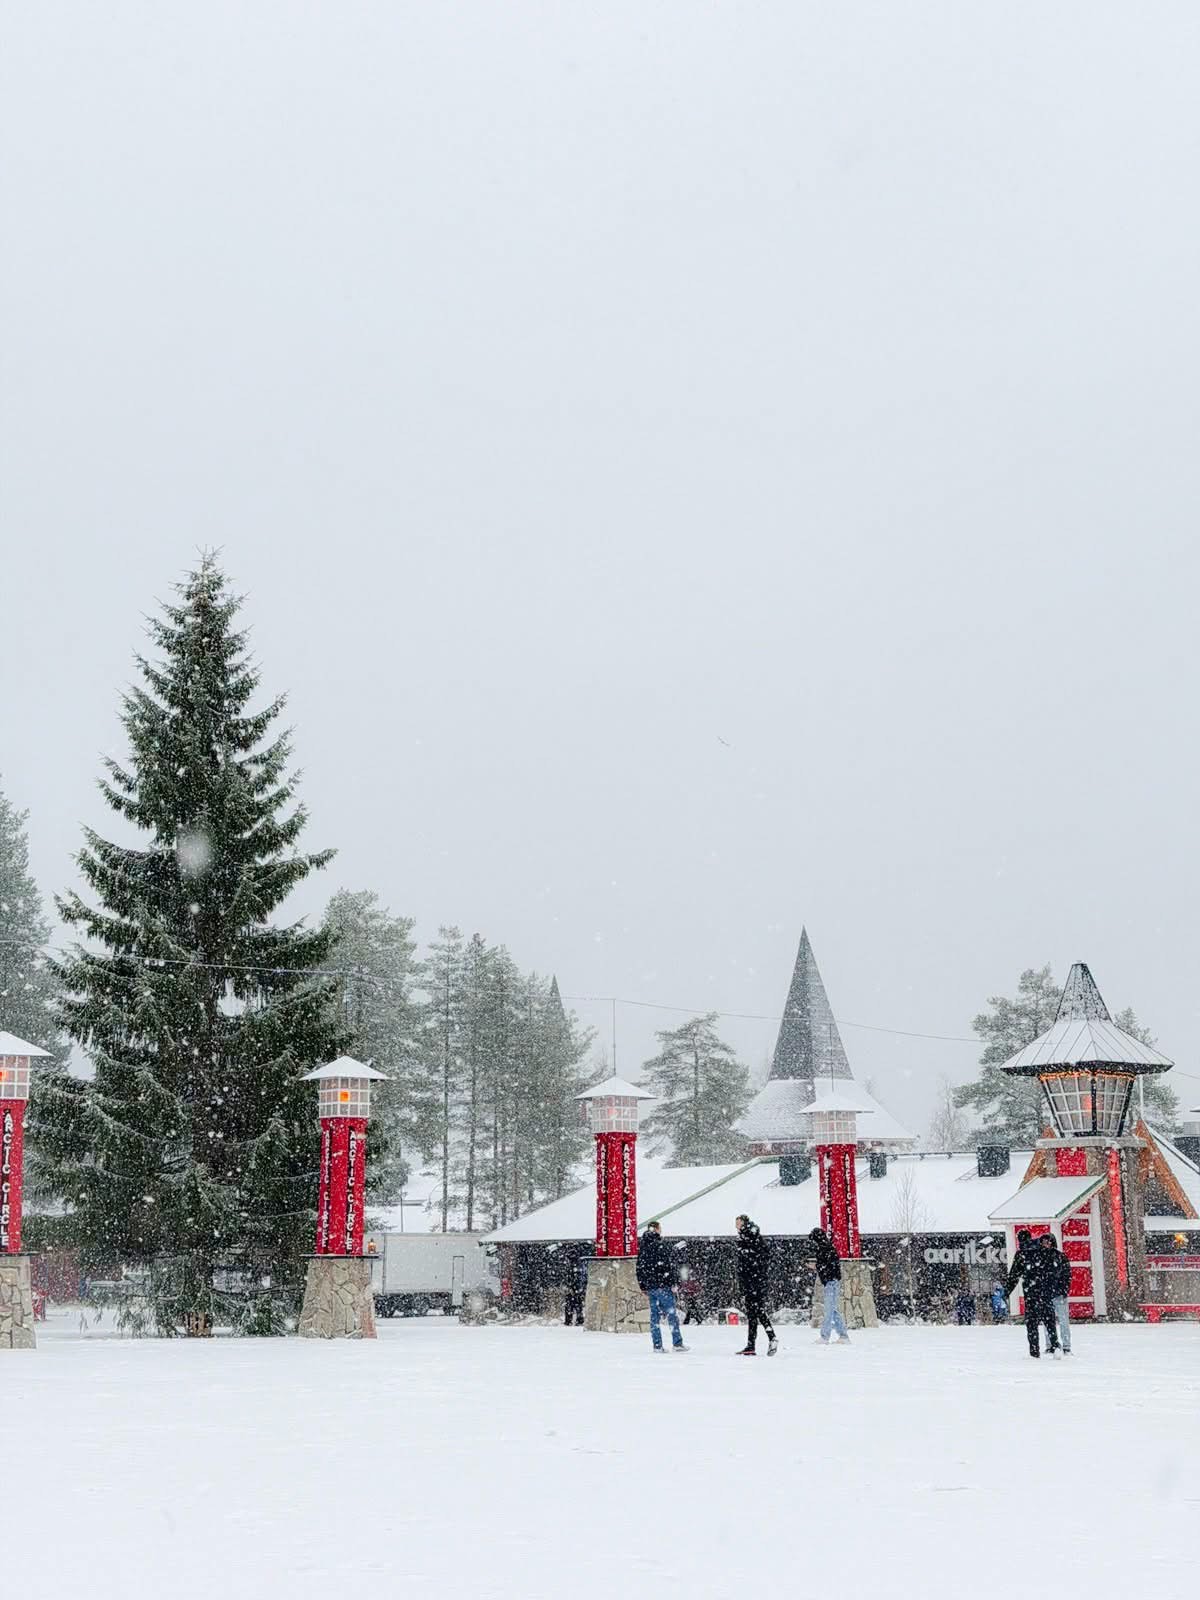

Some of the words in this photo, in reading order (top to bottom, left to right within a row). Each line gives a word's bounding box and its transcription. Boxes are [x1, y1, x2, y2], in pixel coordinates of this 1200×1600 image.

[2, 1113, 13, 1174] ARCTIC
[348, 1130, 357, 1187] ARCTIC
[1120, 1149, 1130, 1216] ARCTIC
[0, 1182, 10, 1246] CIRCLE
[346, 1194, 355, 1250] CIRCLE
[624, 1202, 632, 1253] CIRCLE
